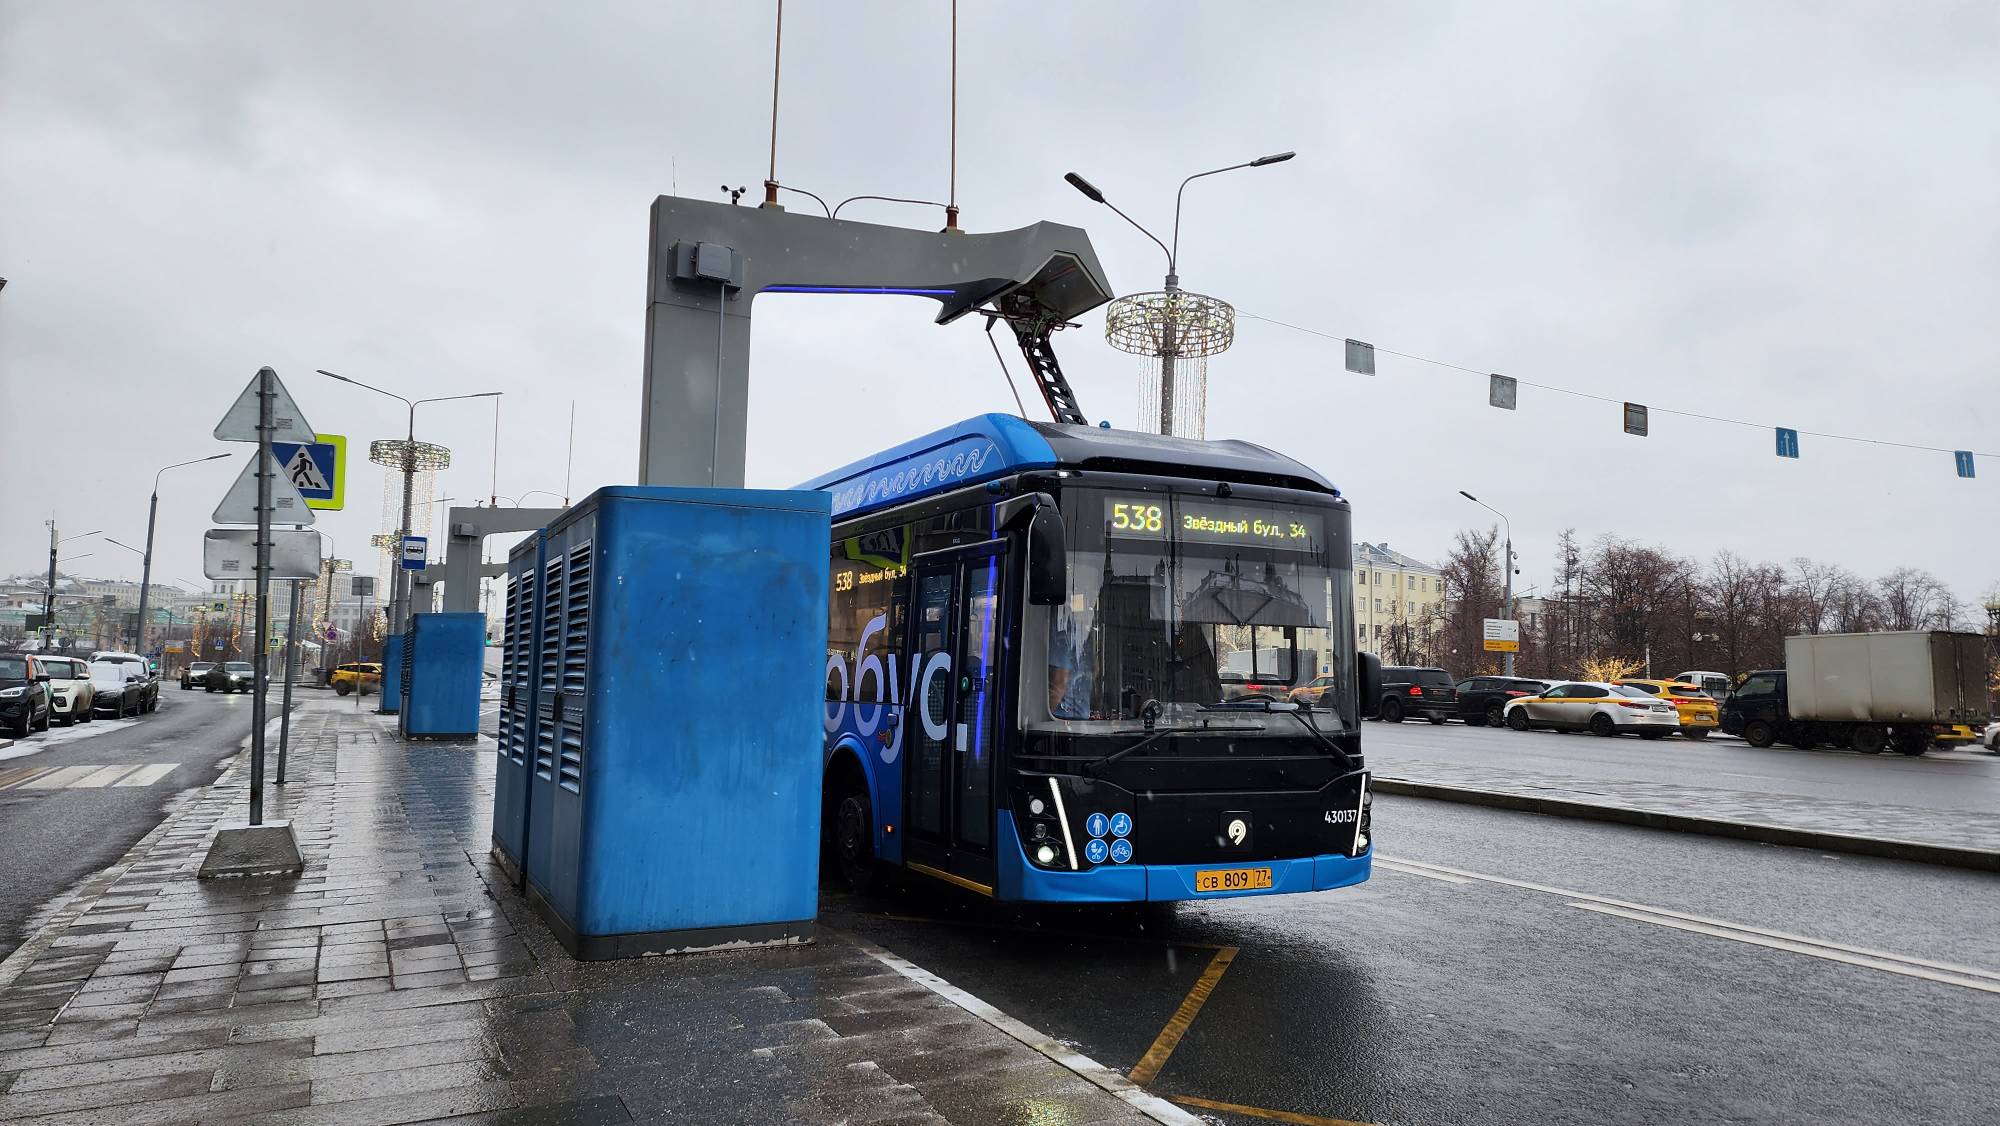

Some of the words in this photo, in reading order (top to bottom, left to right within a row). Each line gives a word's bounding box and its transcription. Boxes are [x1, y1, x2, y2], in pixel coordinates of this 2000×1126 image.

[1112, 503, 1162, 532] 538
[1183, 515, 1248, 534] Звёздный
[1289, 523, 1306, 538] 34
[836, 570, 853, 592] 538
[1324, 809, 1357, 824] 430137
[1202, 877, 1218, 888] СВ
[1224, 872, 1248, 887] 809
[1255, 870, 1267, 882] 77
